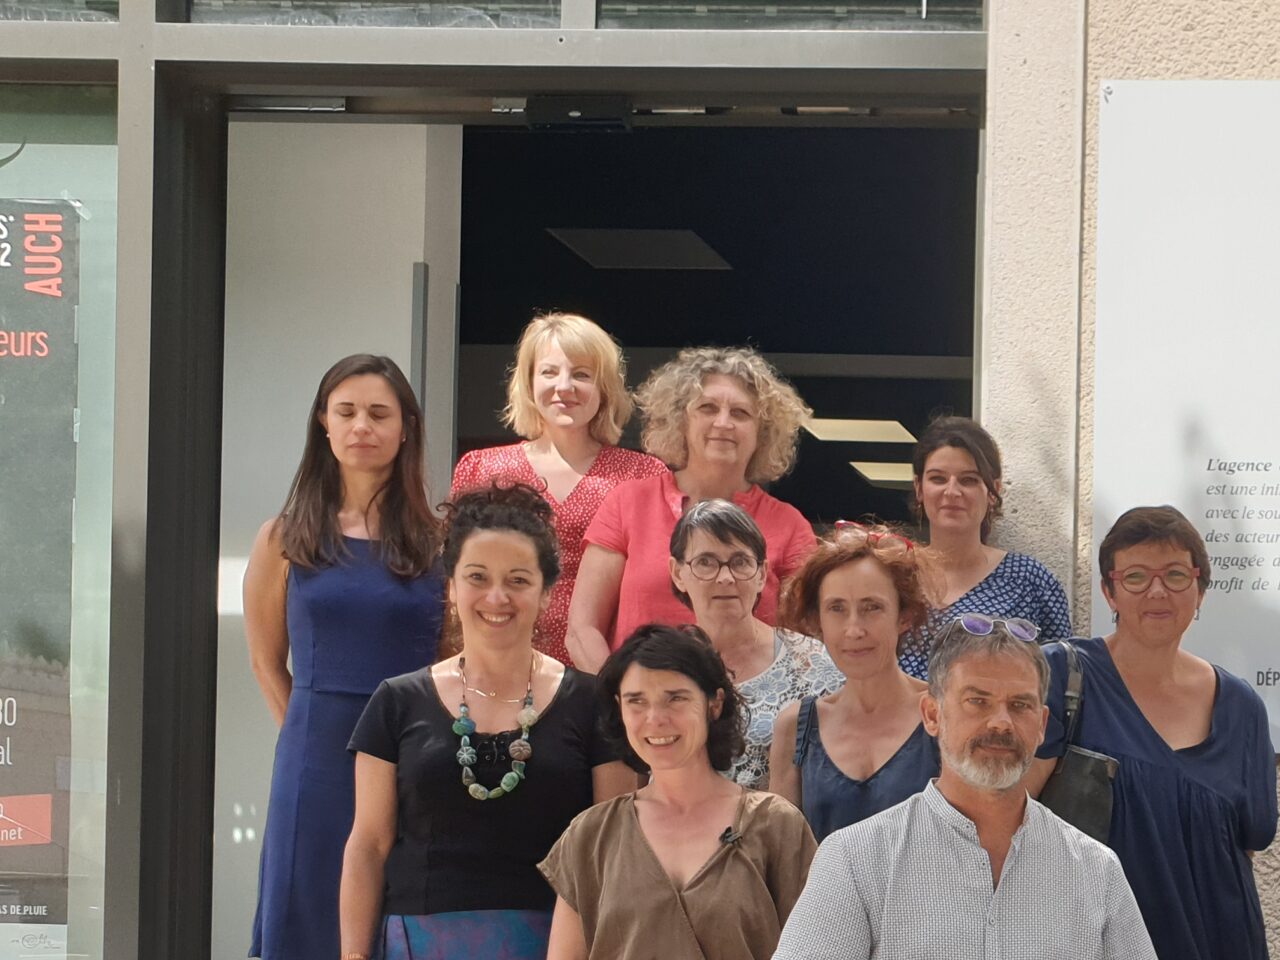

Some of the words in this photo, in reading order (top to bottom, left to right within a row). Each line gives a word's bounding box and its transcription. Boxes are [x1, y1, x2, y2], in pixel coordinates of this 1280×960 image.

[24, 213, 63, 297] AUCH
[1206, 458, 1272, 475] L'agence
[1206, 484, 1226, 496] est
[1230, 485, 1257, 496] une
[1205, 508, 1239, 520] avec
[1241, 506, 1255, 520] le
[1205, 529, 1230, 544] des
[1251, 577, 1270, 592] de
[23, 905, 49, 916] PLUIE
